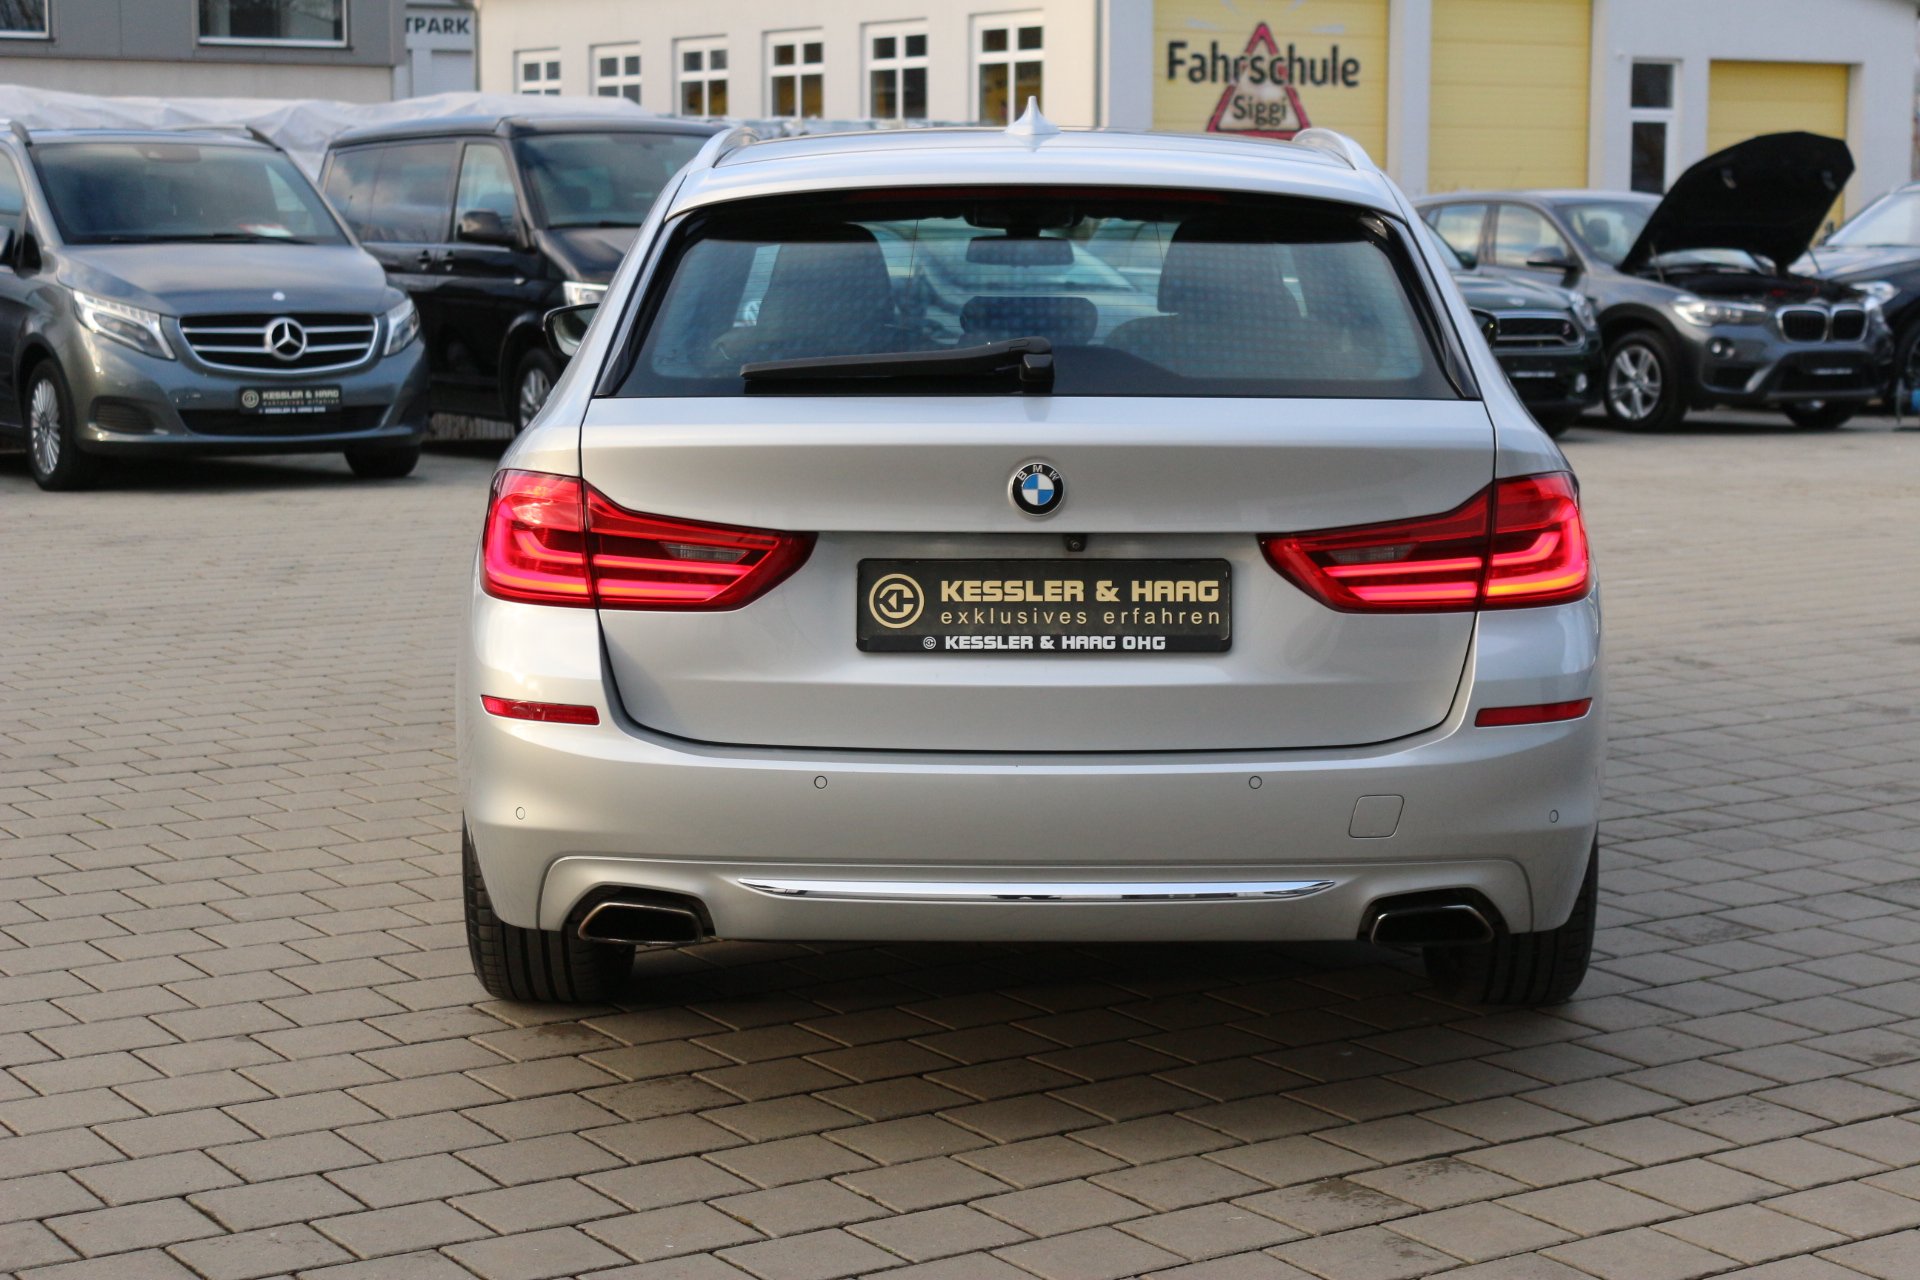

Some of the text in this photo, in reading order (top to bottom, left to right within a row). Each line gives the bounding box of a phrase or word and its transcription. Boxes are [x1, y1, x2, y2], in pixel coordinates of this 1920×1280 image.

[1168, 41, 1360, 87] Fahrschule
[1233, 95, 1287, 126] Siggi
[1017, 464, 1060, 481] BMW
[941, 580, 1219, 602] KESSLER & HAAG
[941, 608, 1221, 625] exklusives erfahren
[945, 635, 1166, 650] KESSLER & HAAG OHG
